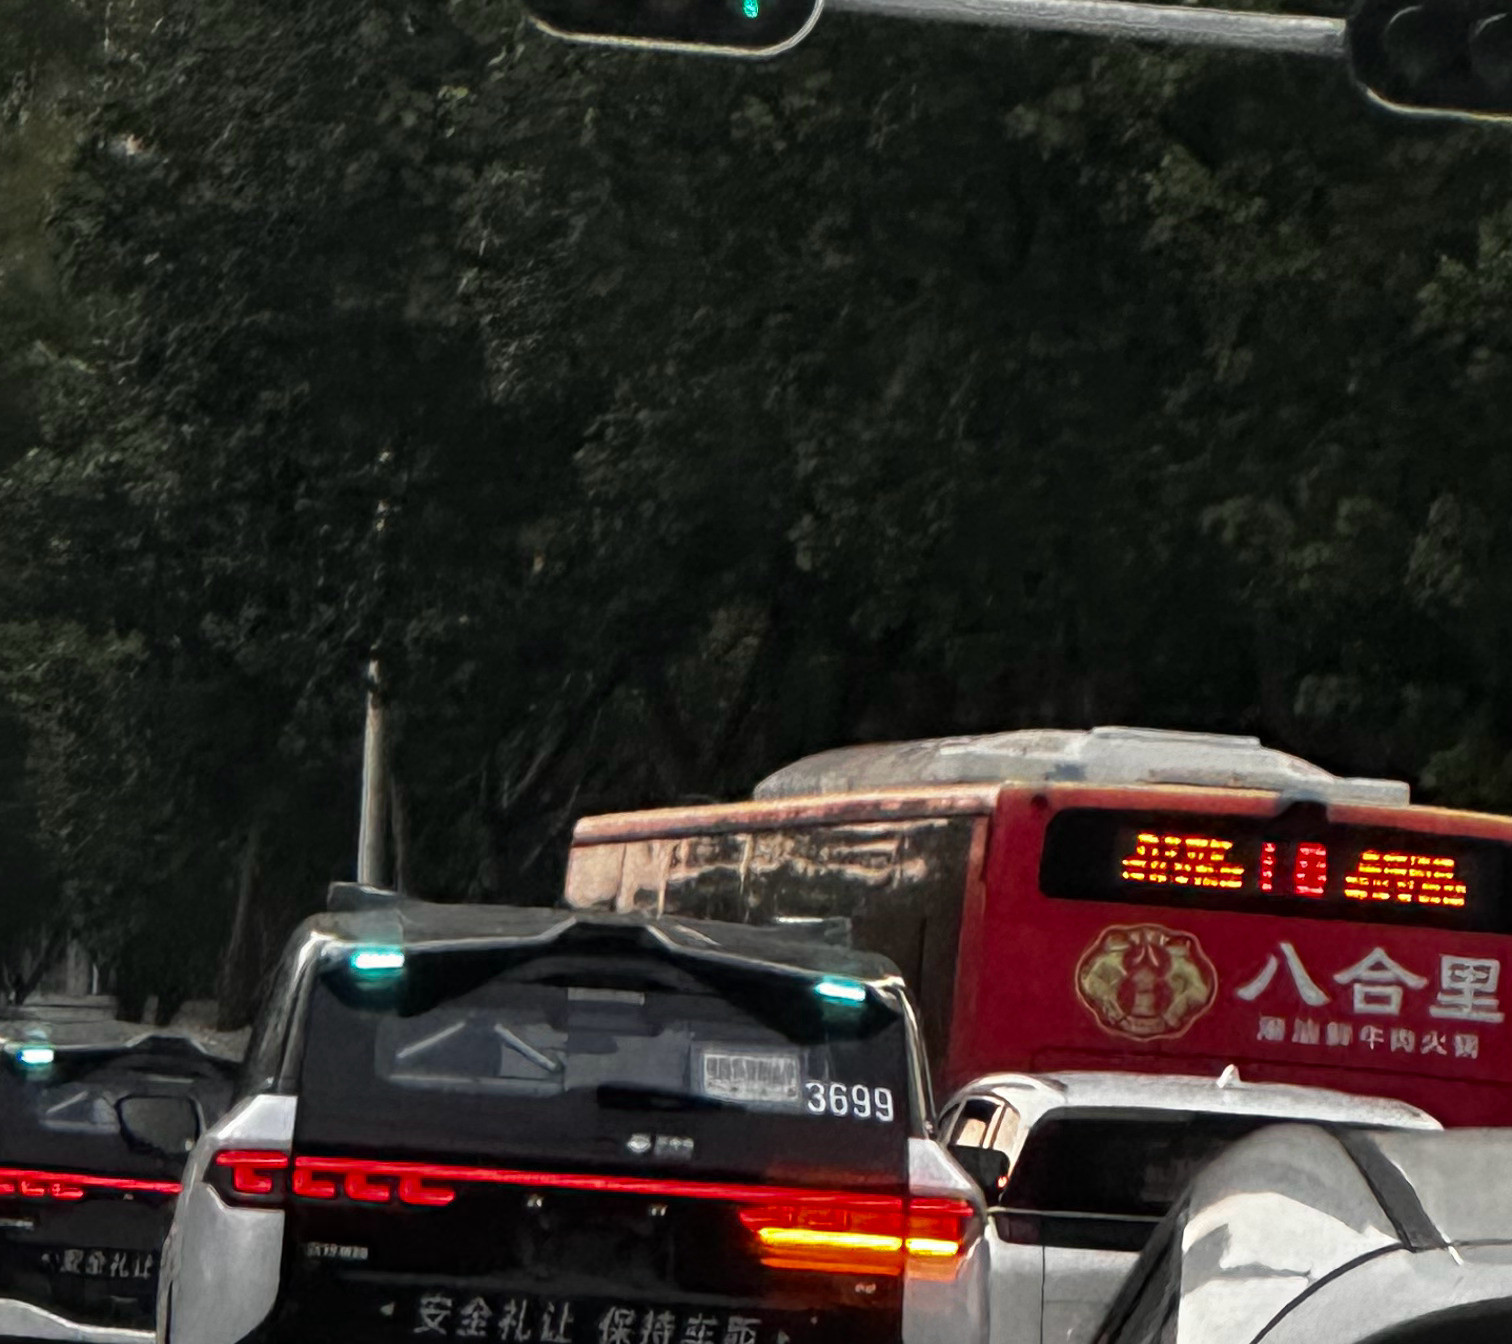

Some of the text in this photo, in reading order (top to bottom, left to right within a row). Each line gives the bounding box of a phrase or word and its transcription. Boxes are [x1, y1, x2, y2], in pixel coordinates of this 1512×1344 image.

[1235, 940, 1505, 1023] 八合里
[805, 1082, 894, 1123] 3699
[414, 1296, 574, 1344] 安全礼让
